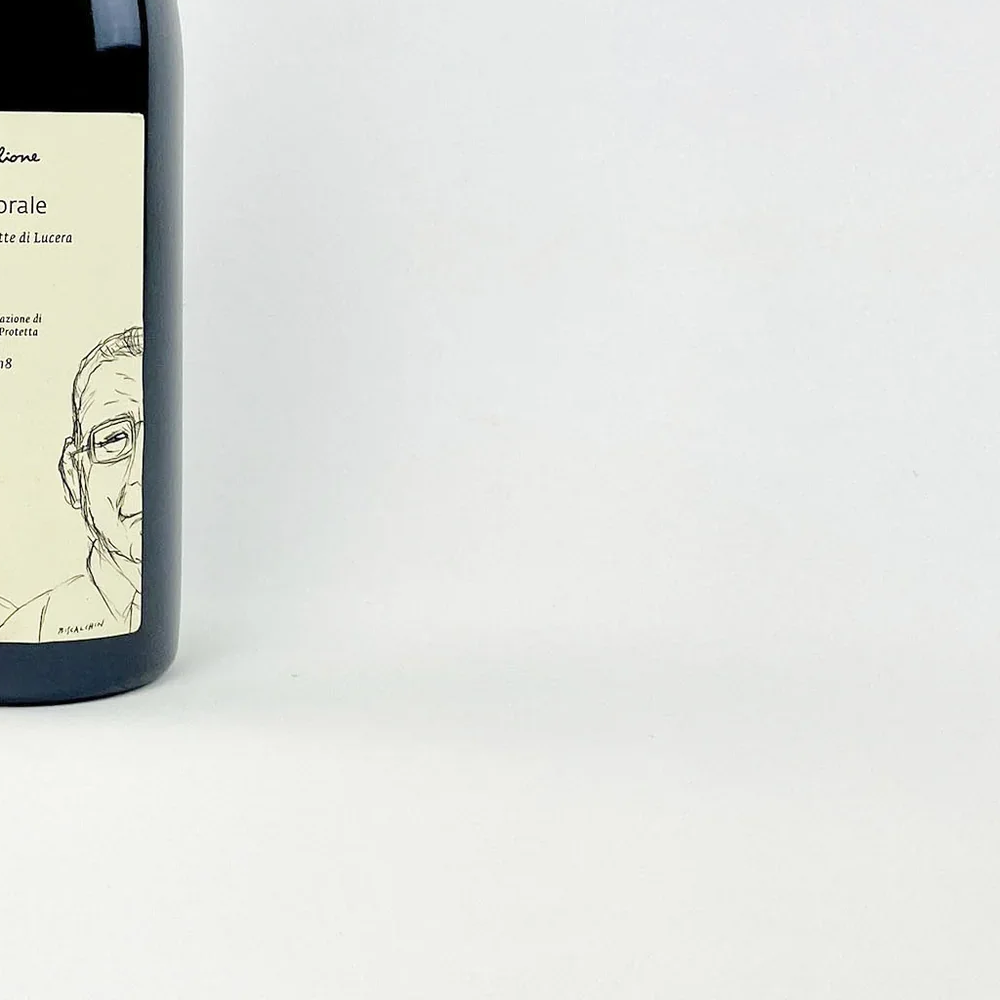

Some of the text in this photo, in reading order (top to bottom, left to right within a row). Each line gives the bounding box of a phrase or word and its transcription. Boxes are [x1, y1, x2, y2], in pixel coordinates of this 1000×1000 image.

[18, 231, 31, 243] di
[33, 231, 73, 243] Lucera
[32, 312, 42, 323] di
